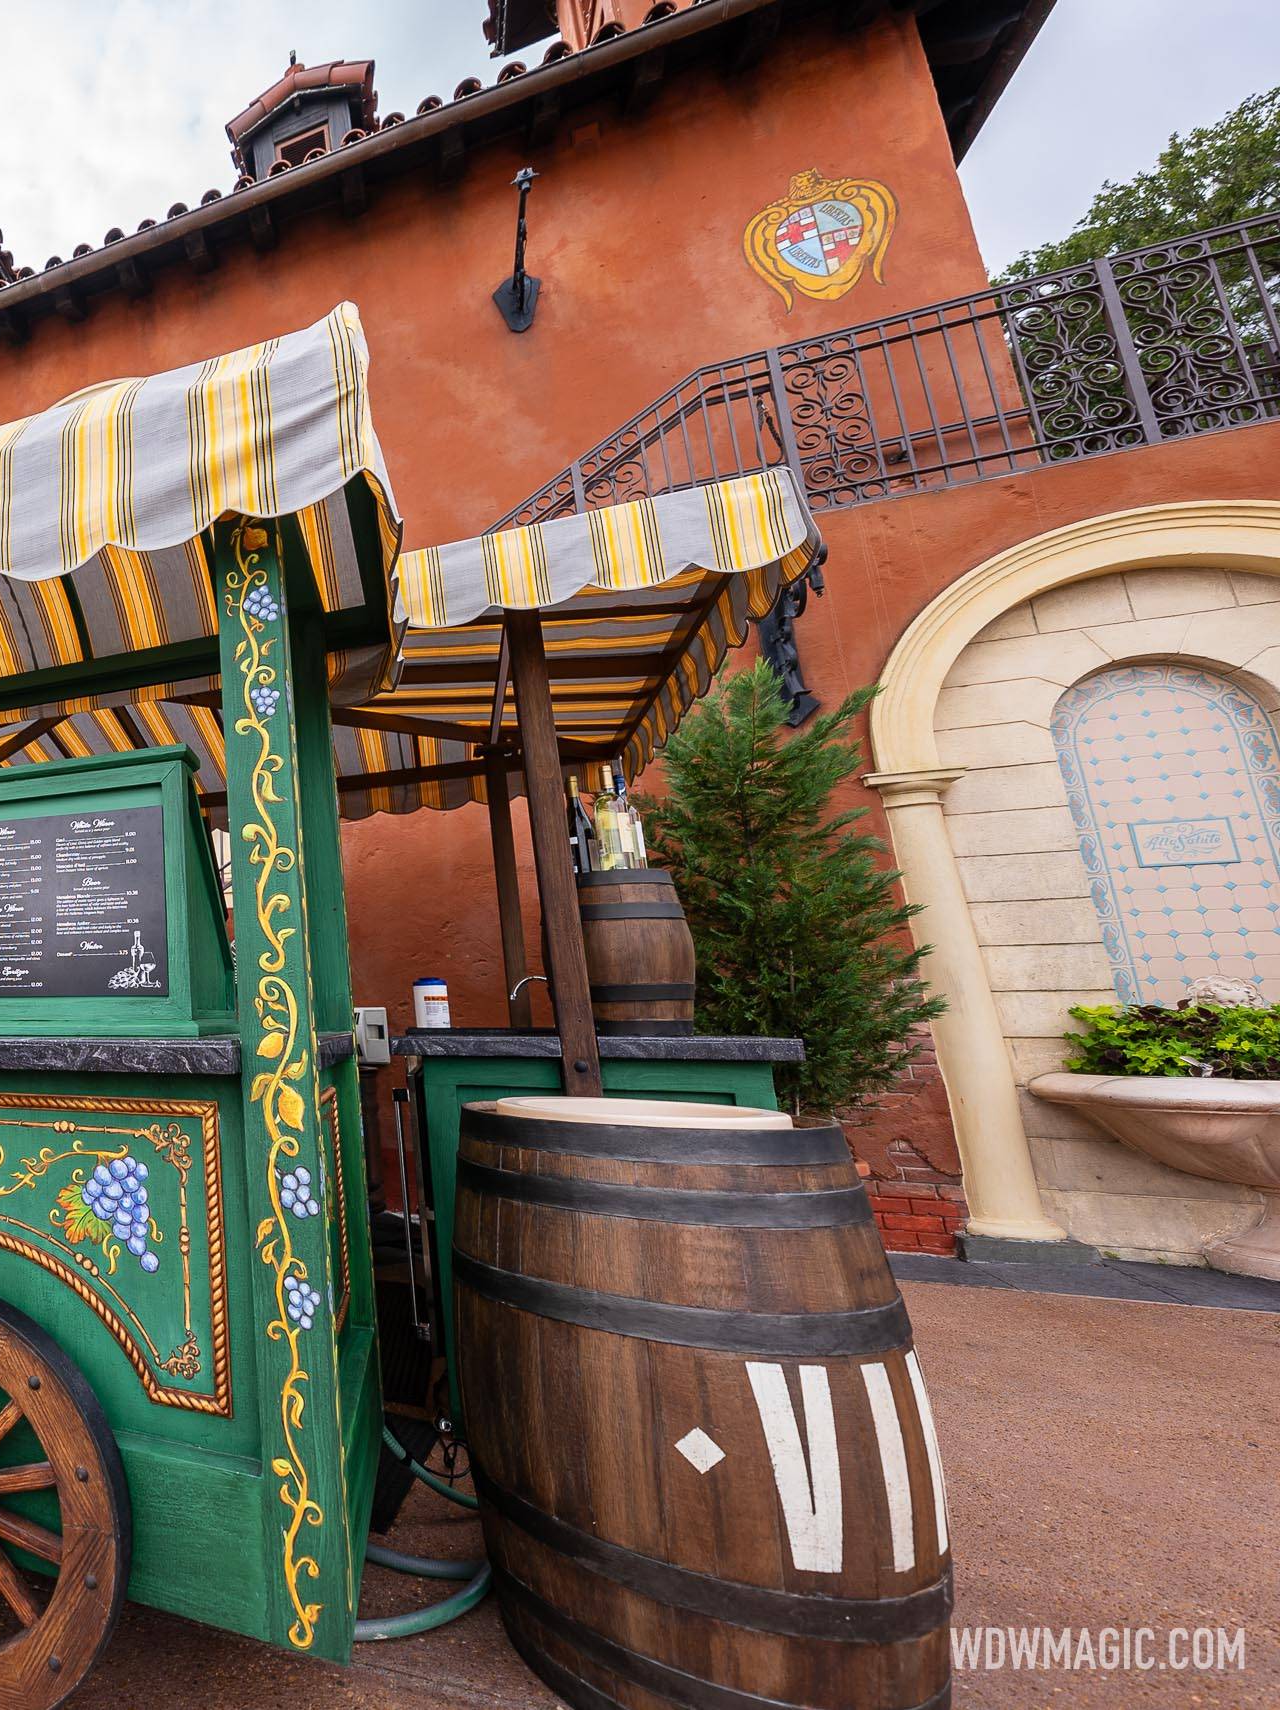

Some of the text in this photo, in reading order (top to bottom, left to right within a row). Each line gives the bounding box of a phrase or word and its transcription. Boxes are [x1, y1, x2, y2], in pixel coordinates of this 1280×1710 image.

[819, 203, 854, 226] LIBERTAS
[788, 245, 822, 268] LIBERTAS
[82, 877, 101, 886] Beer
